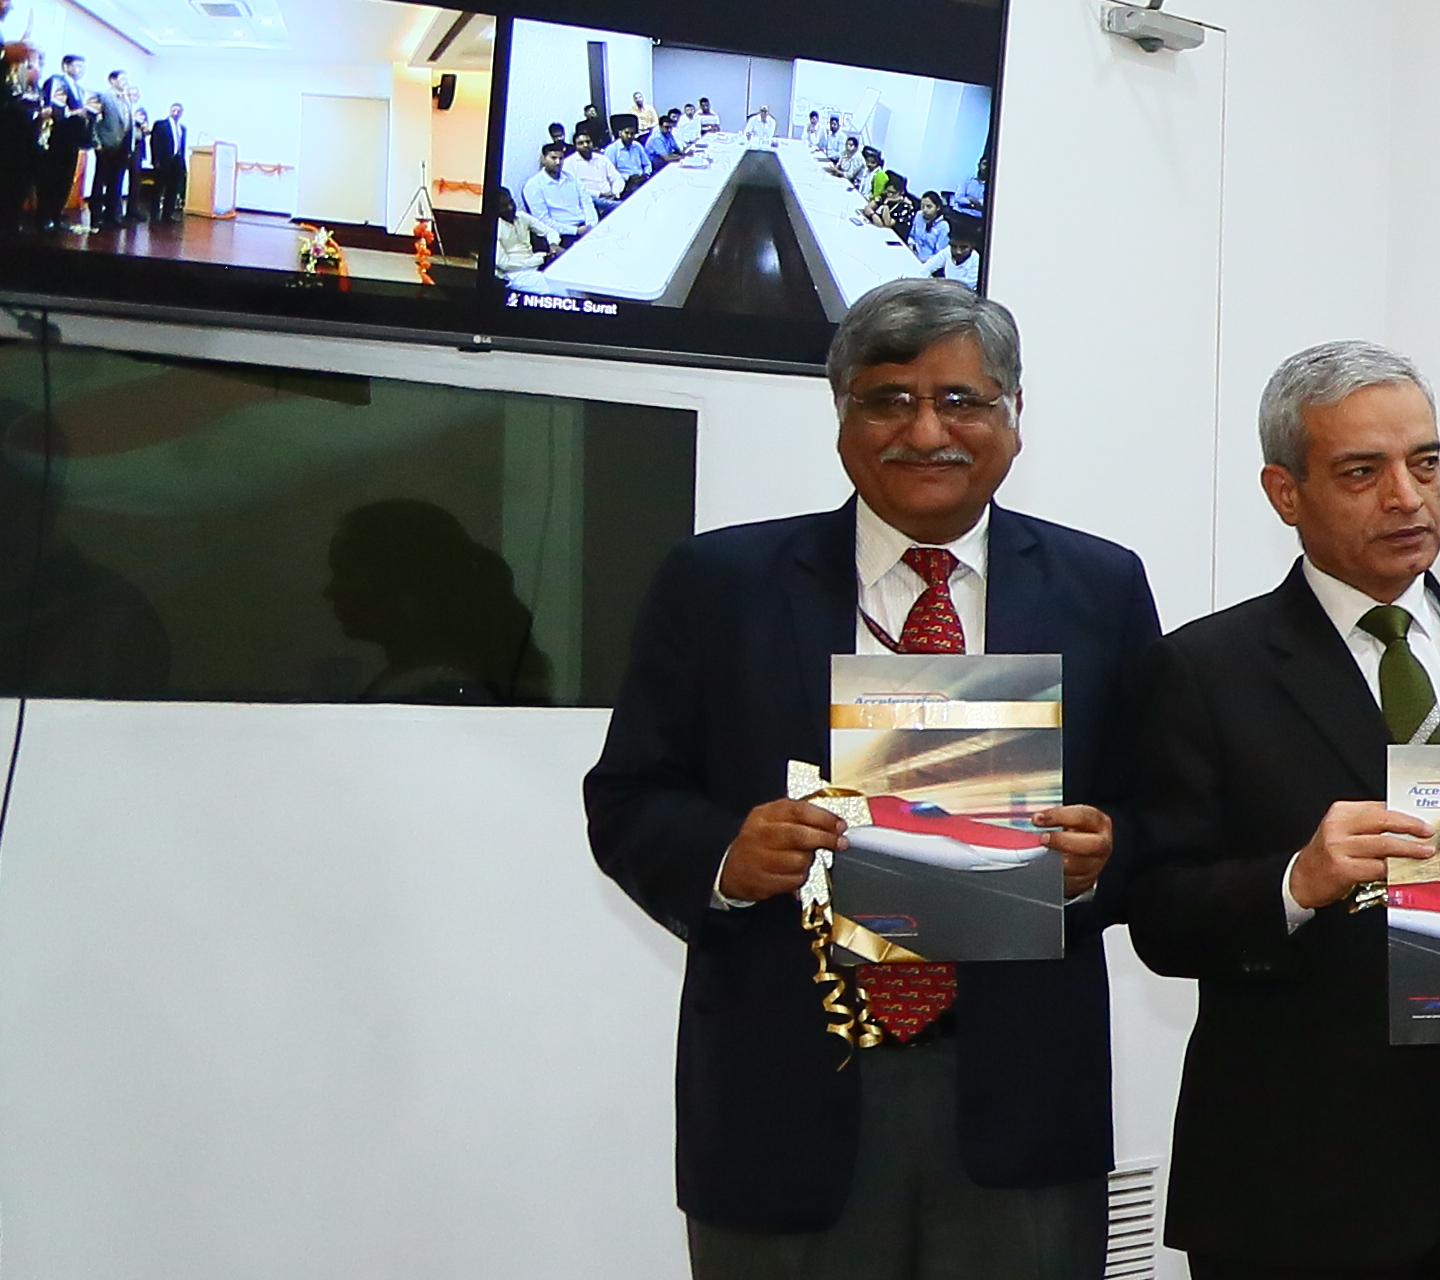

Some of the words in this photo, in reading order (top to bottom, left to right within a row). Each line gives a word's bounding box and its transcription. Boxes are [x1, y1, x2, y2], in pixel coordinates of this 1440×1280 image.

[523, 294, 580, 312] NHSRCL
[583, 300, 618, 315] Surat
[1416, 798, 1439, 807] the
